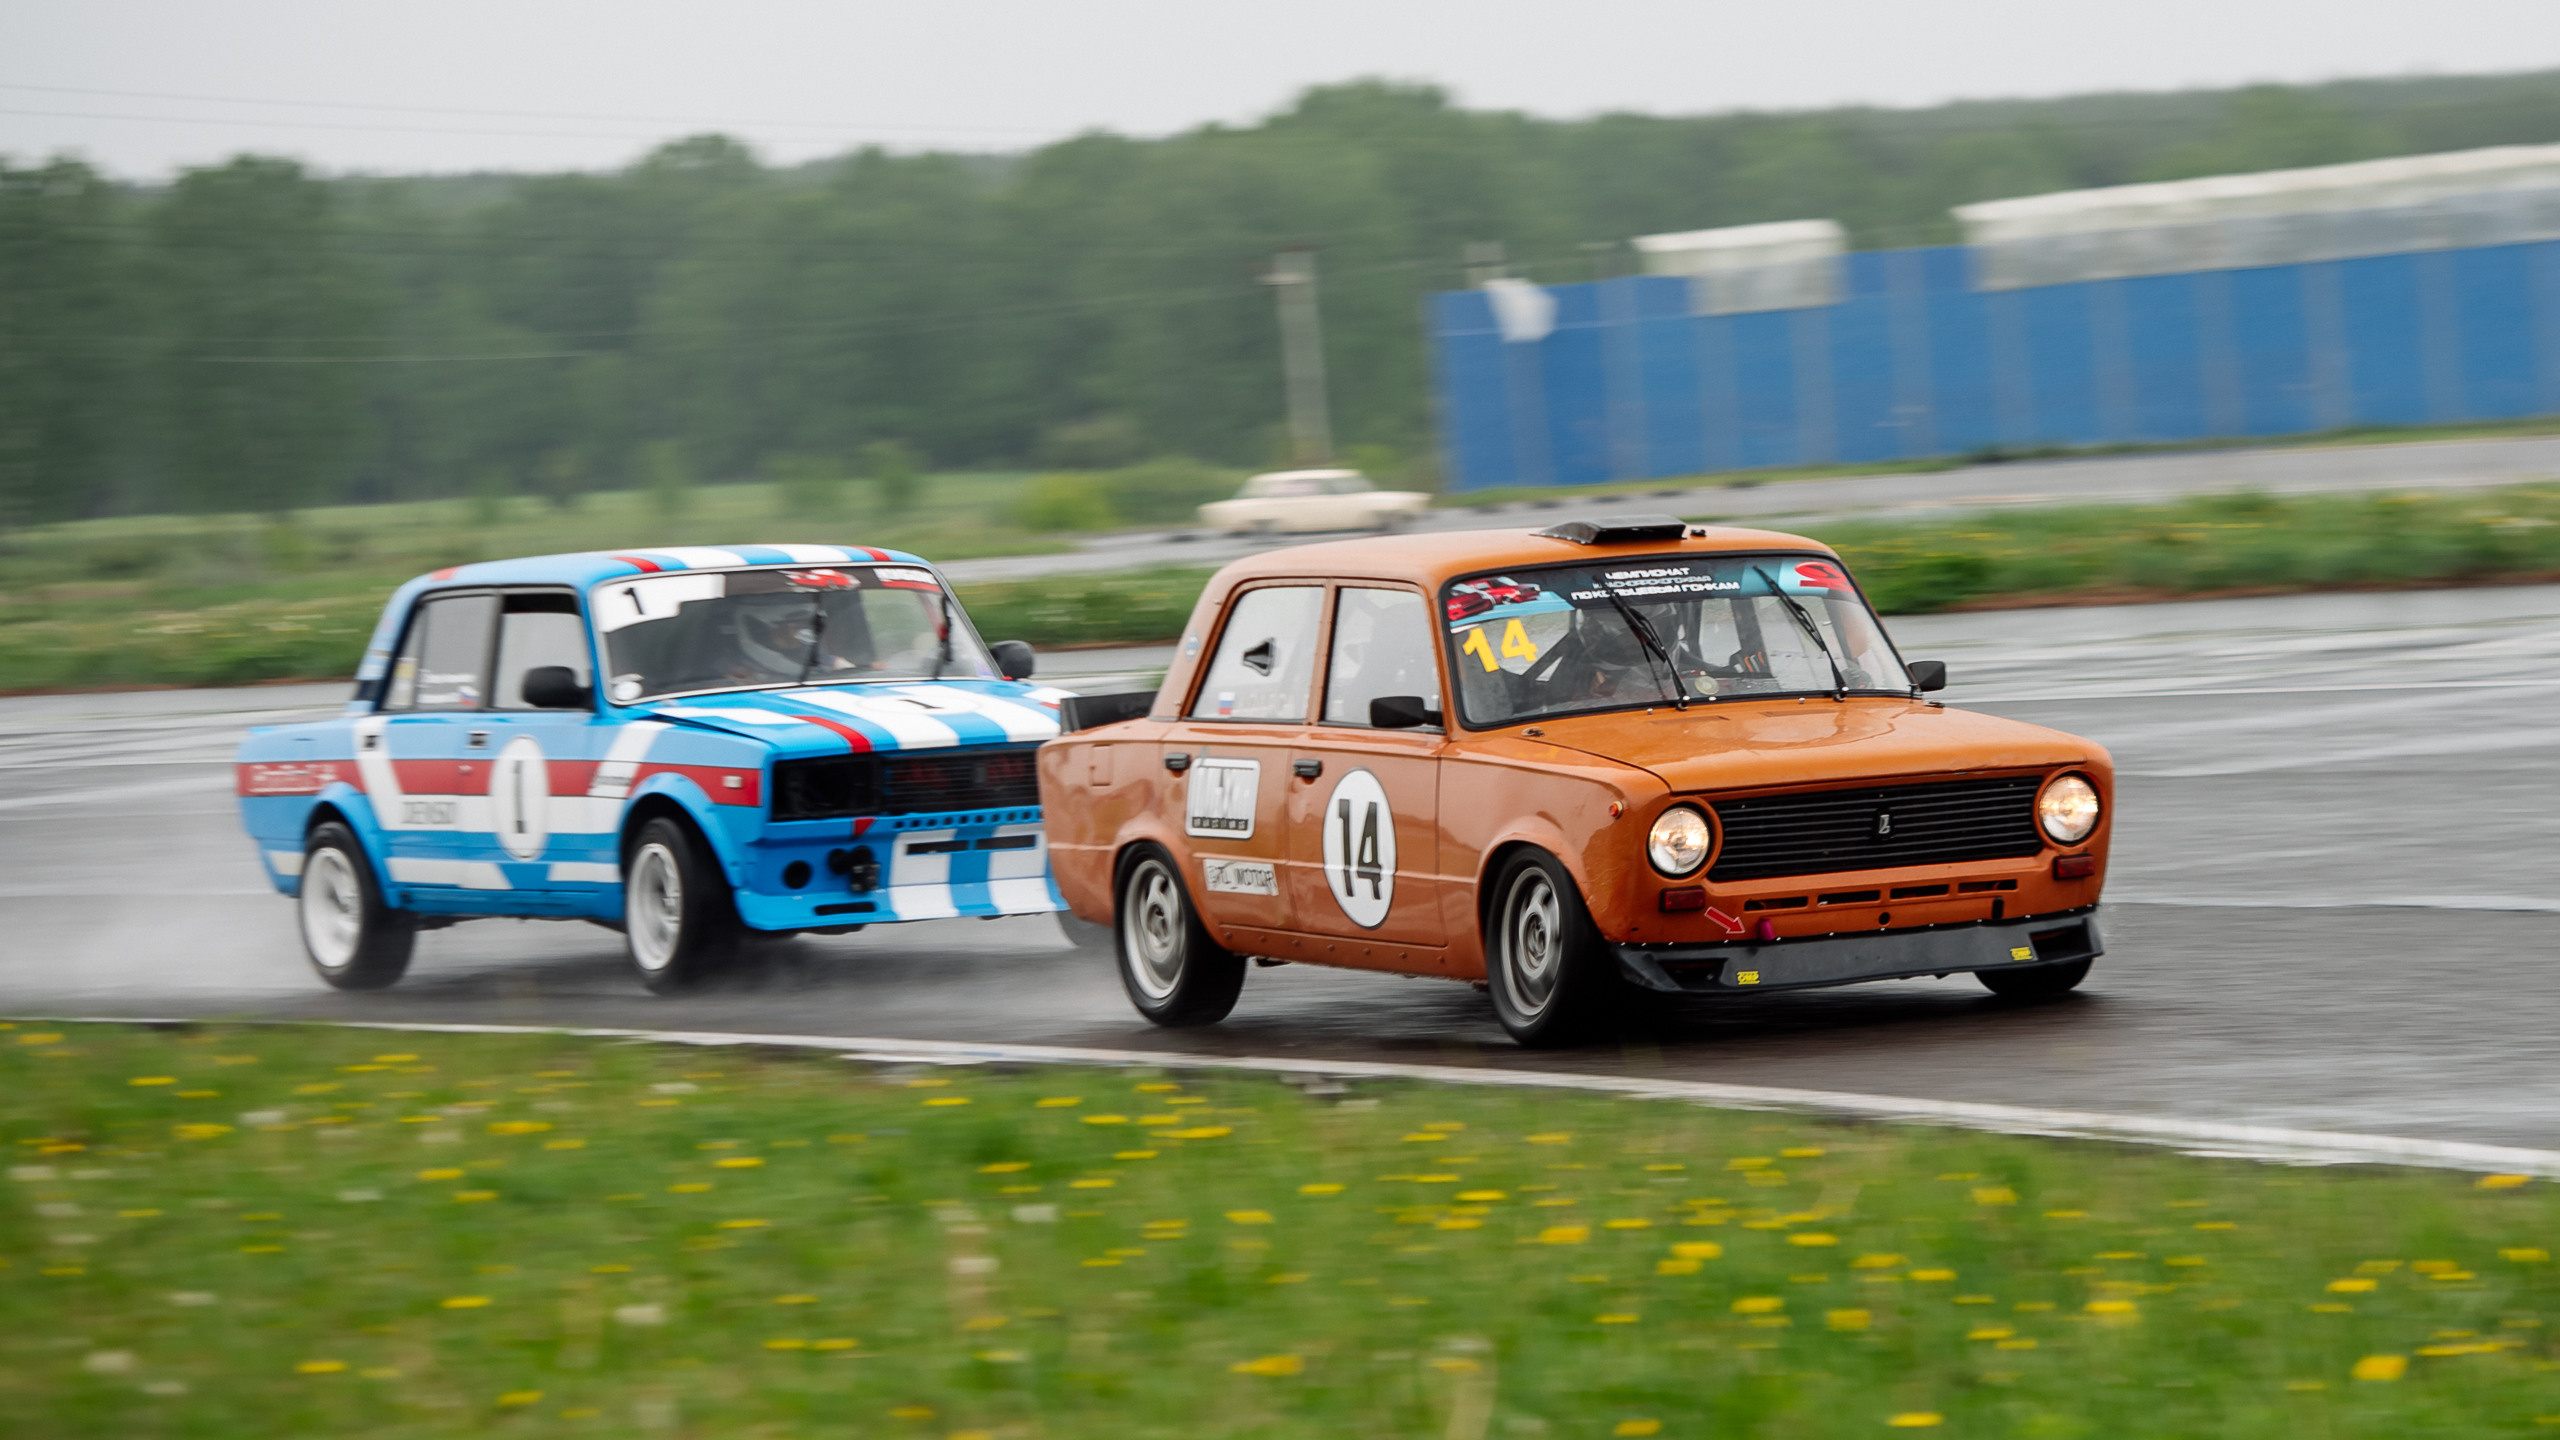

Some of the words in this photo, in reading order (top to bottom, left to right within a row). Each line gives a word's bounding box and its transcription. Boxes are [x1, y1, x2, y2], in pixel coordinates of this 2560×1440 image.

[1605, 567, 1691, 580] ЧЕМПИОНАТ
[1683, 581, 1740, 593] ГОНКАМ
[622, 587, 645, 615] 1
[1462, 618, 1538, 673] 14
[513, 759, 527, 834] 1
[1338, 798, 1382, 900] 14
